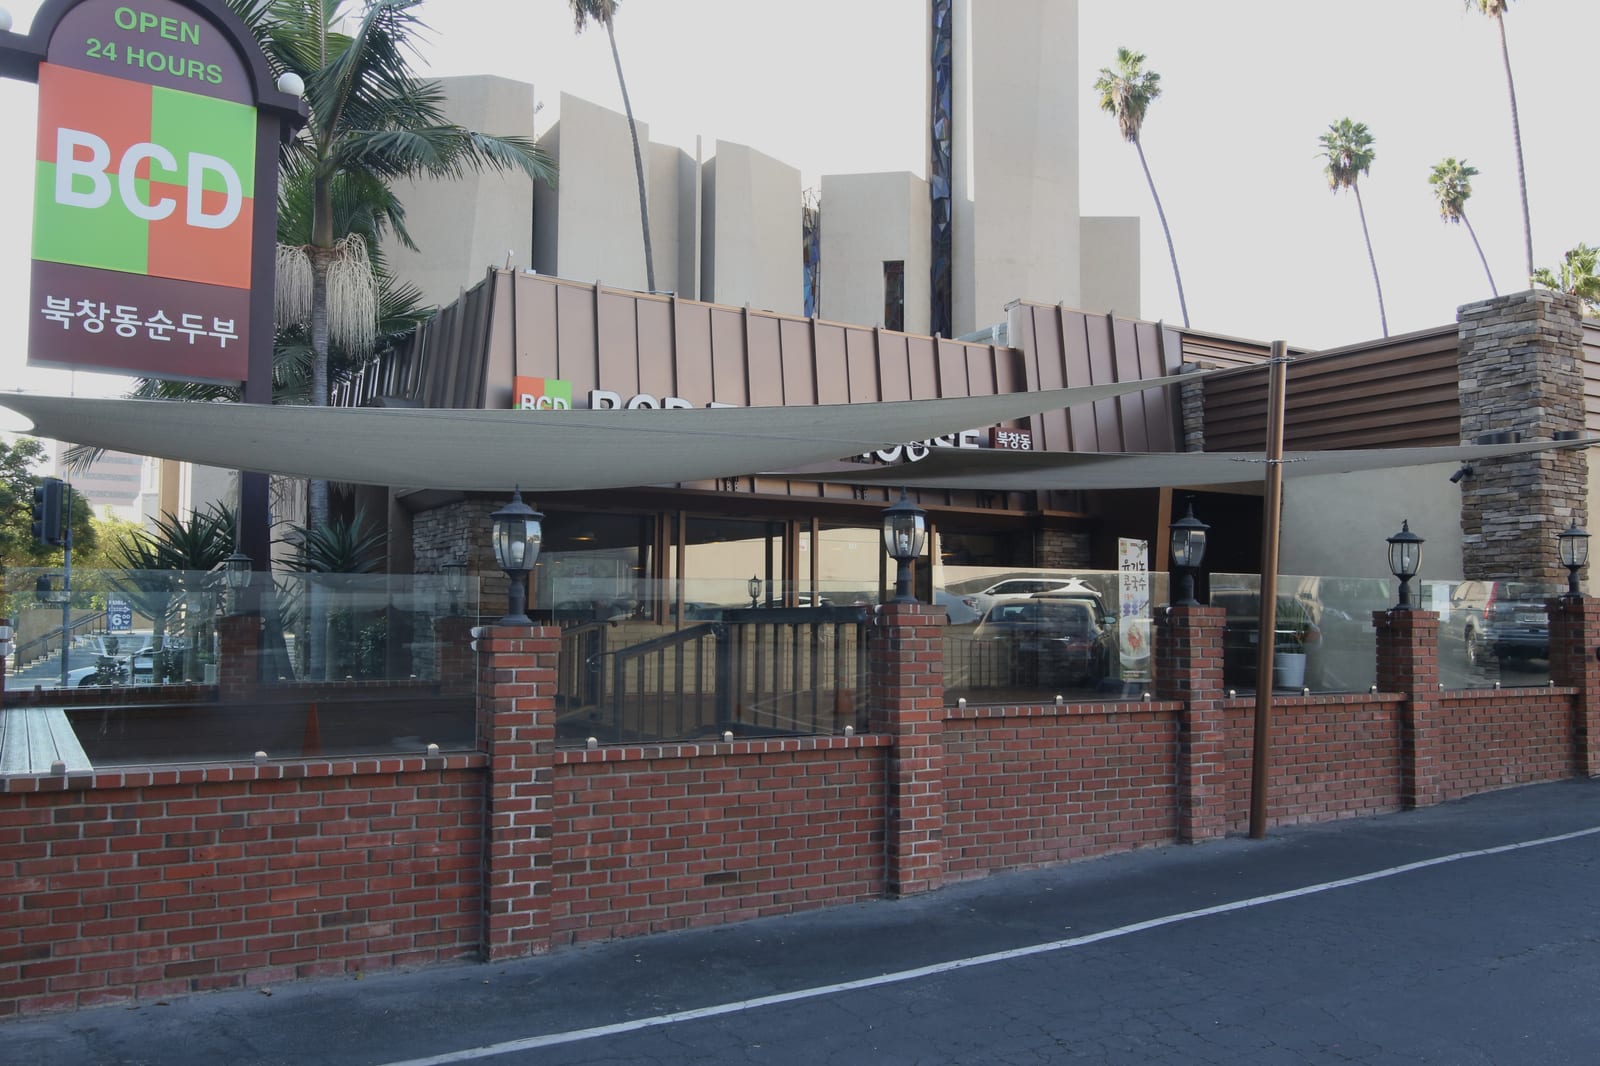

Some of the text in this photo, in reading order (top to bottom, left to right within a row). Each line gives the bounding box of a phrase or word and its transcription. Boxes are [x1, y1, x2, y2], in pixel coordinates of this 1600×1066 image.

[114, 7, 200, 46] OPEN
[86, 38, 223, 85] 24 HOURS
[55, 127, 243, 230] BCD
[41, 295, 239, 348] 북창동순두부
[997, 431, 1031, 450] 북창동
